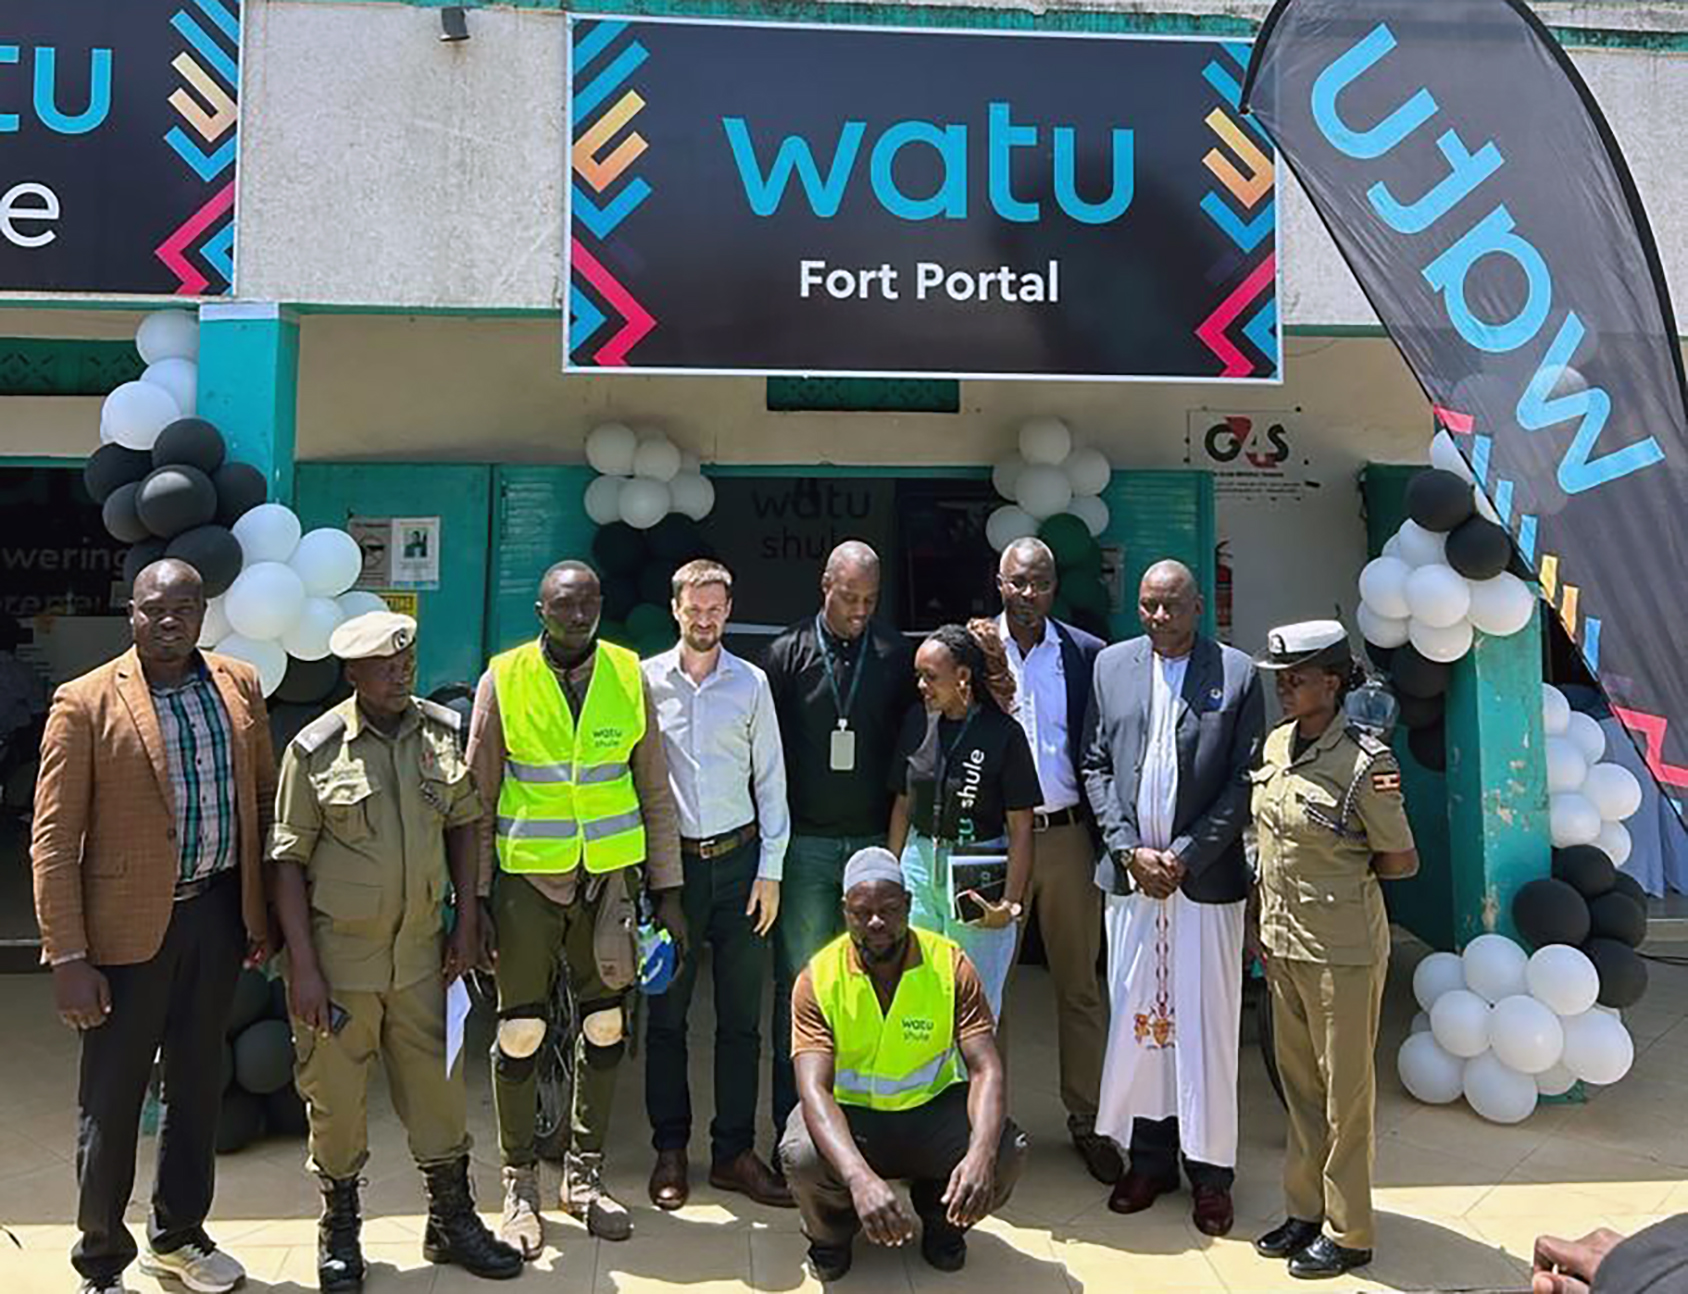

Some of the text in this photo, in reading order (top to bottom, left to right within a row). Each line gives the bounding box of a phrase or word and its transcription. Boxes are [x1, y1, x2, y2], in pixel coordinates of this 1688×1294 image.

[723, 102, 1133, 224] watu
[800, 260, 1059, 302] Fort Portal
[1204, 414, 1289, 469] G4S
[750, 482, 871, 519] watu
[760, 525, 835, 560] shul
[956, 749, 985, 808] shule
